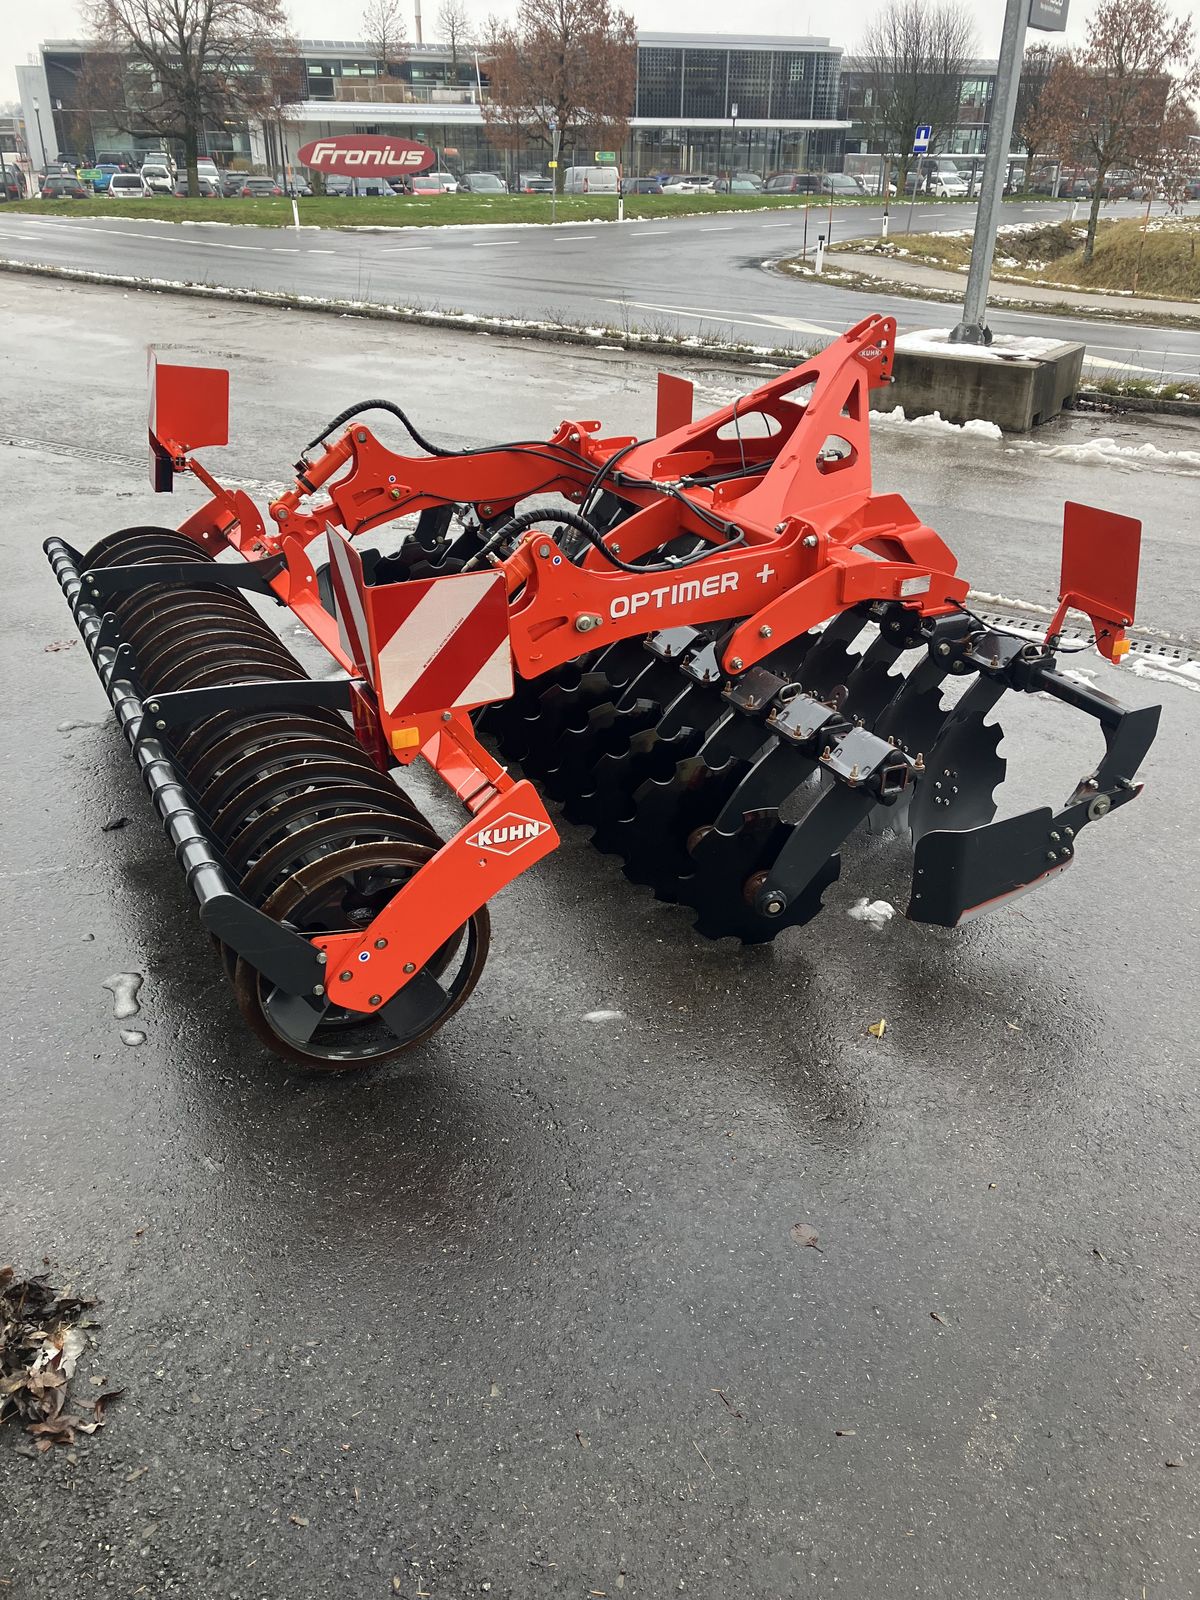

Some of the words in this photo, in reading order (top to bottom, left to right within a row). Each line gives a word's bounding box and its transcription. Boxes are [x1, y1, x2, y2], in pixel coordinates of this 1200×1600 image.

[310, 142, 425, 165] Fronius
[861, 349, 880, 357] KUHN
[609, 571, 739, 619] OPTIMER
[478, 822, 540, 847] KUHN
